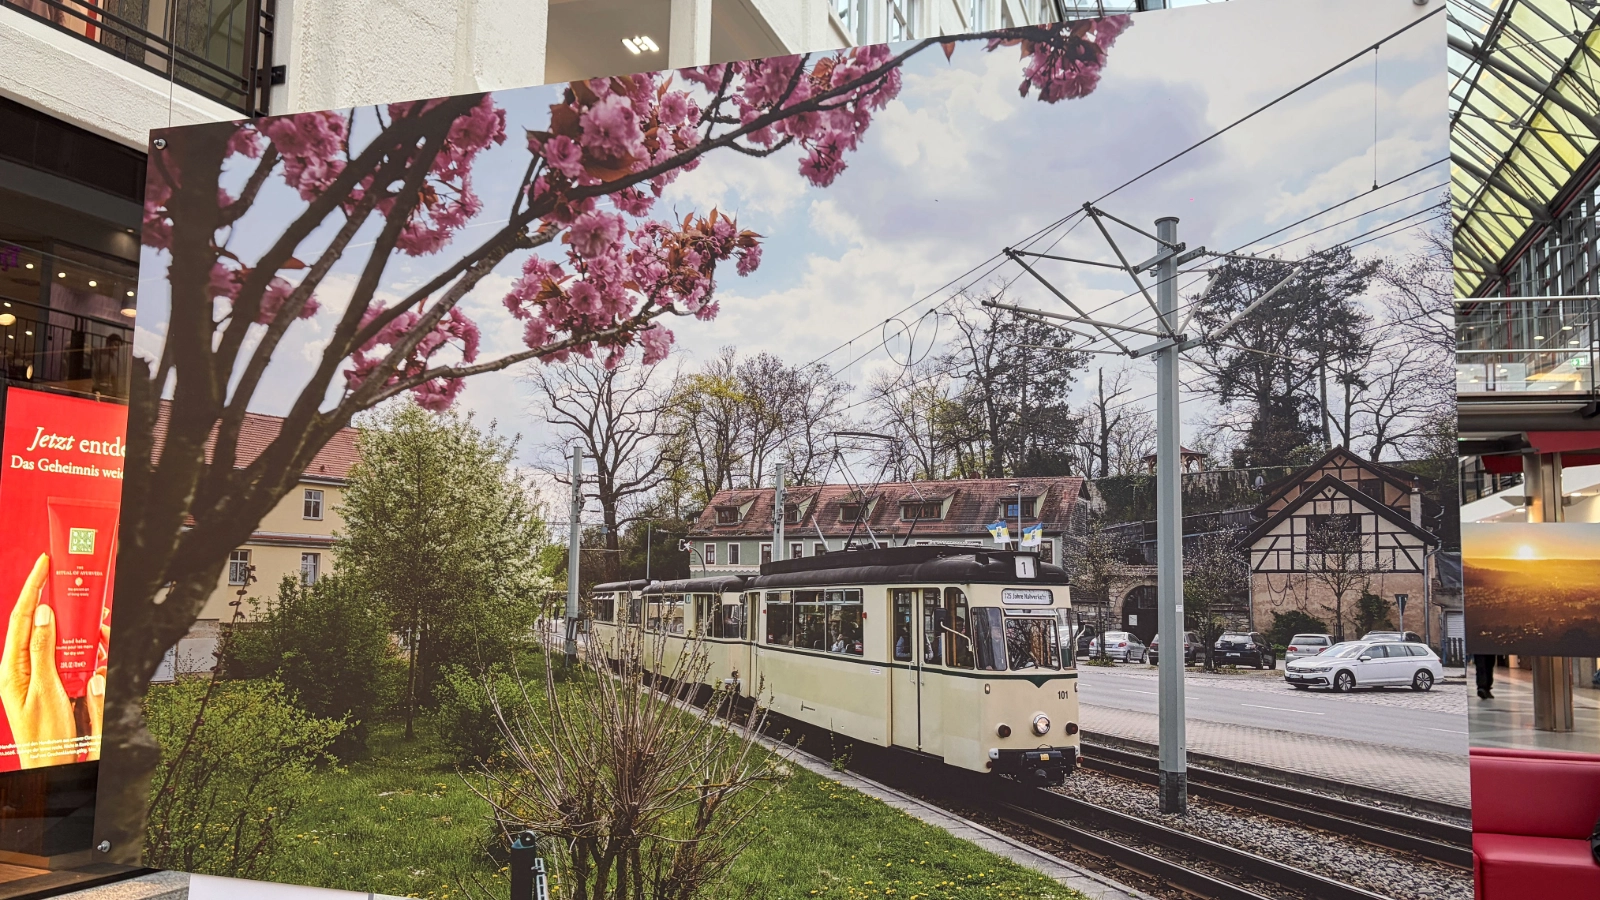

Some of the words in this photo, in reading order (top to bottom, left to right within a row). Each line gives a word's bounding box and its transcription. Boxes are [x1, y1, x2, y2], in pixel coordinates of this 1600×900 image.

[26, 426, 75, 452] Jetzt
[10, 454, 35, 470] Das
[37, 458, 100, 477] Geheimnis
[1021, 561, 1027, 575] 1
[1057, 690, 1069, 700] 101
